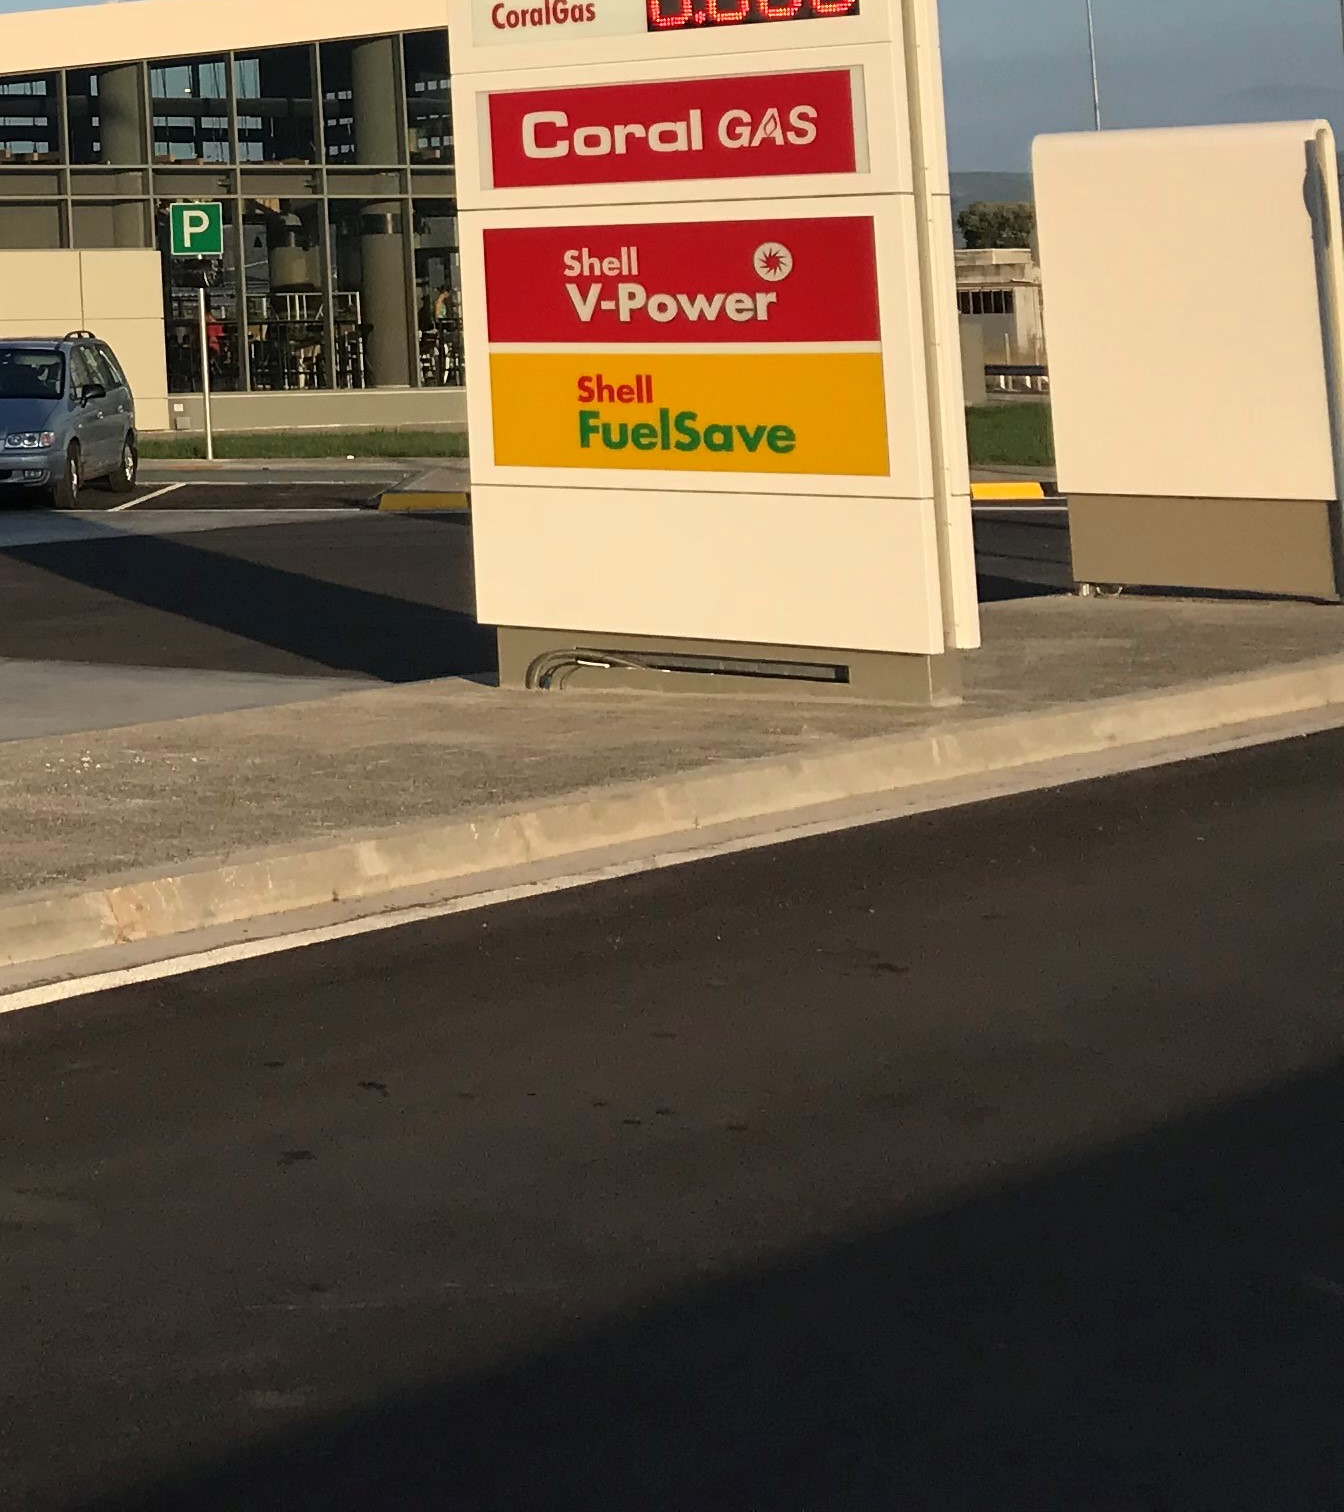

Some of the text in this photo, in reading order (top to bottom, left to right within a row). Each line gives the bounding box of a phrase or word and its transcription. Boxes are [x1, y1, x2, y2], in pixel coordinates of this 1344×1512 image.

[521, 104, 818, 159] Coral GAS
[182, 210, 210, 248] P
[564, 246, 639, 277] Shell
[565, 283, 778, 322] V-Power
[577, 374, 654, 404] Shell
[579, 408, 797, 455] FuelSave
